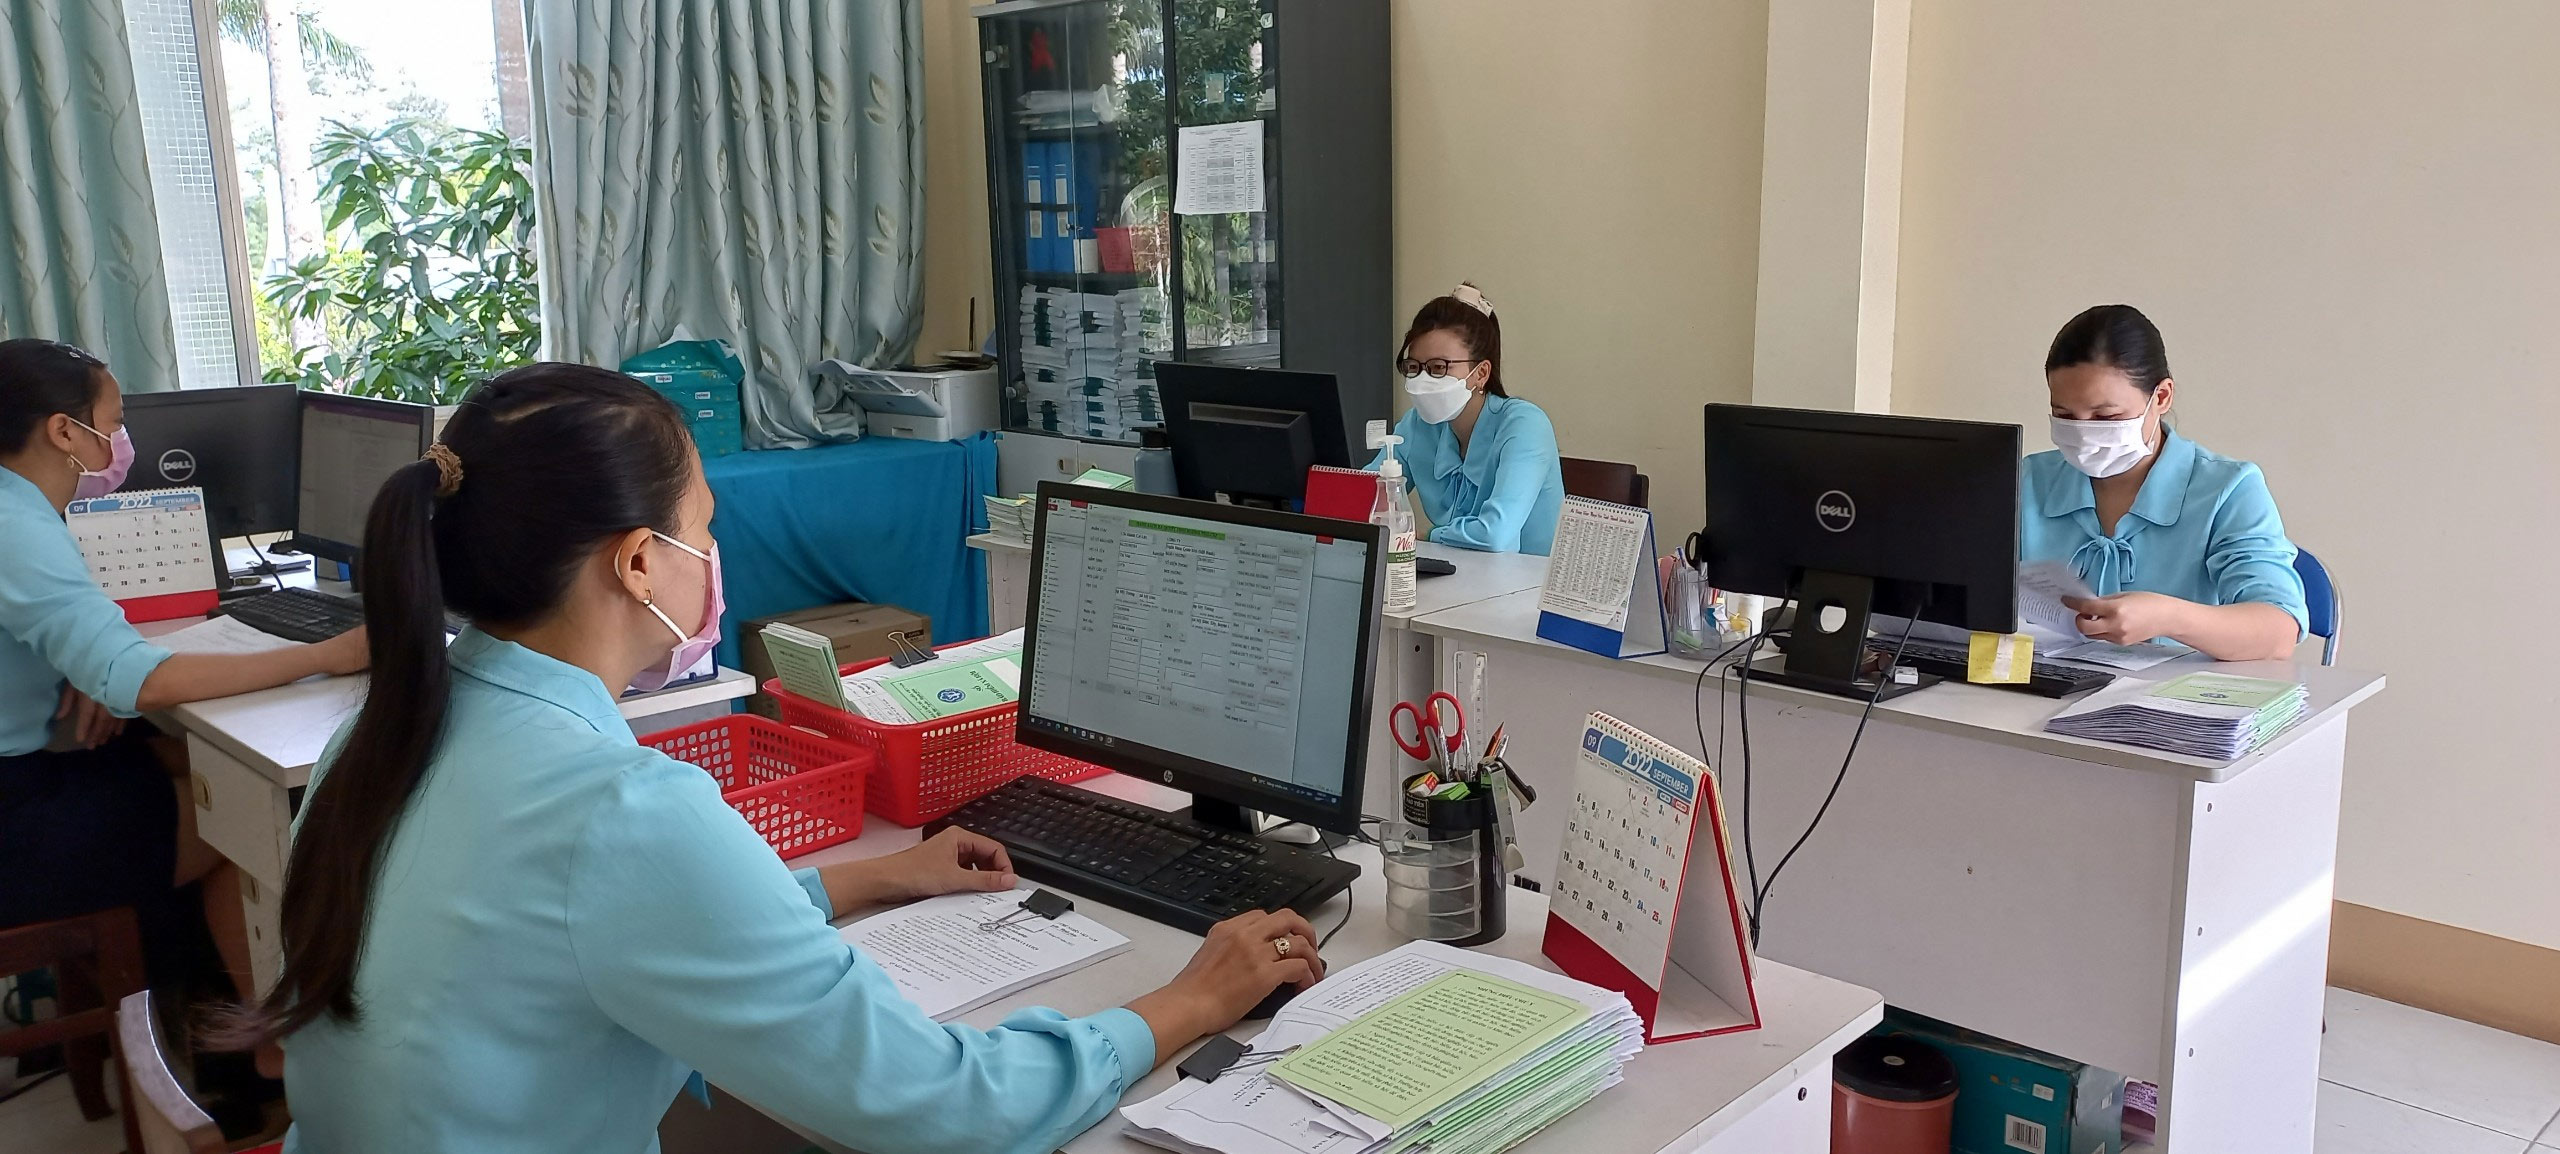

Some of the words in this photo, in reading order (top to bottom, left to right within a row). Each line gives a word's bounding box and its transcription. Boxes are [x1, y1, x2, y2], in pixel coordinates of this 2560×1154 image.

[163, 461, 191, 470] DELL
[119, 497, 154, 510] 2022
[1820, 505, 1850, 517] DELL
[1587, 735, 1597, 747] 09
[1621, 746, 1654, 778] 2022
[1652, 768, 1689, 796] SEPTEMBER
[1569, 822, 1575, 832] 12
[1584, 830, 1590, 840] 13
[1599, 839, 1605, 850] 14
[1614, 849, 1620, 859] 15
[1629, 858, 1635, 869] 16
[1644, 868, 1650, 878] 17
[1659, 878, 1665, 889] 18
[1650, 836, 1657, 846] 10
[1665, 845, 1672, 857] 11
[1563, 851, 1569, 861] 19
[1577, 860, 1584, 870] 20
[1592, 869, 1598, 880] 21
[1607, 879, 1614, 890] 22
[1622, 889, 1629, 900] 23
[1637, 900, 1643, 911] 24
[1652, 910, 1659, 922] 25
[1558, 881, 1564, 891] 26
[1572, 890, 1578, 901] 27
[1586, 900, 1593, 911] 28
[1601, 910, 1608, 921] 29
[1616, 920, 1623, 932] 30
